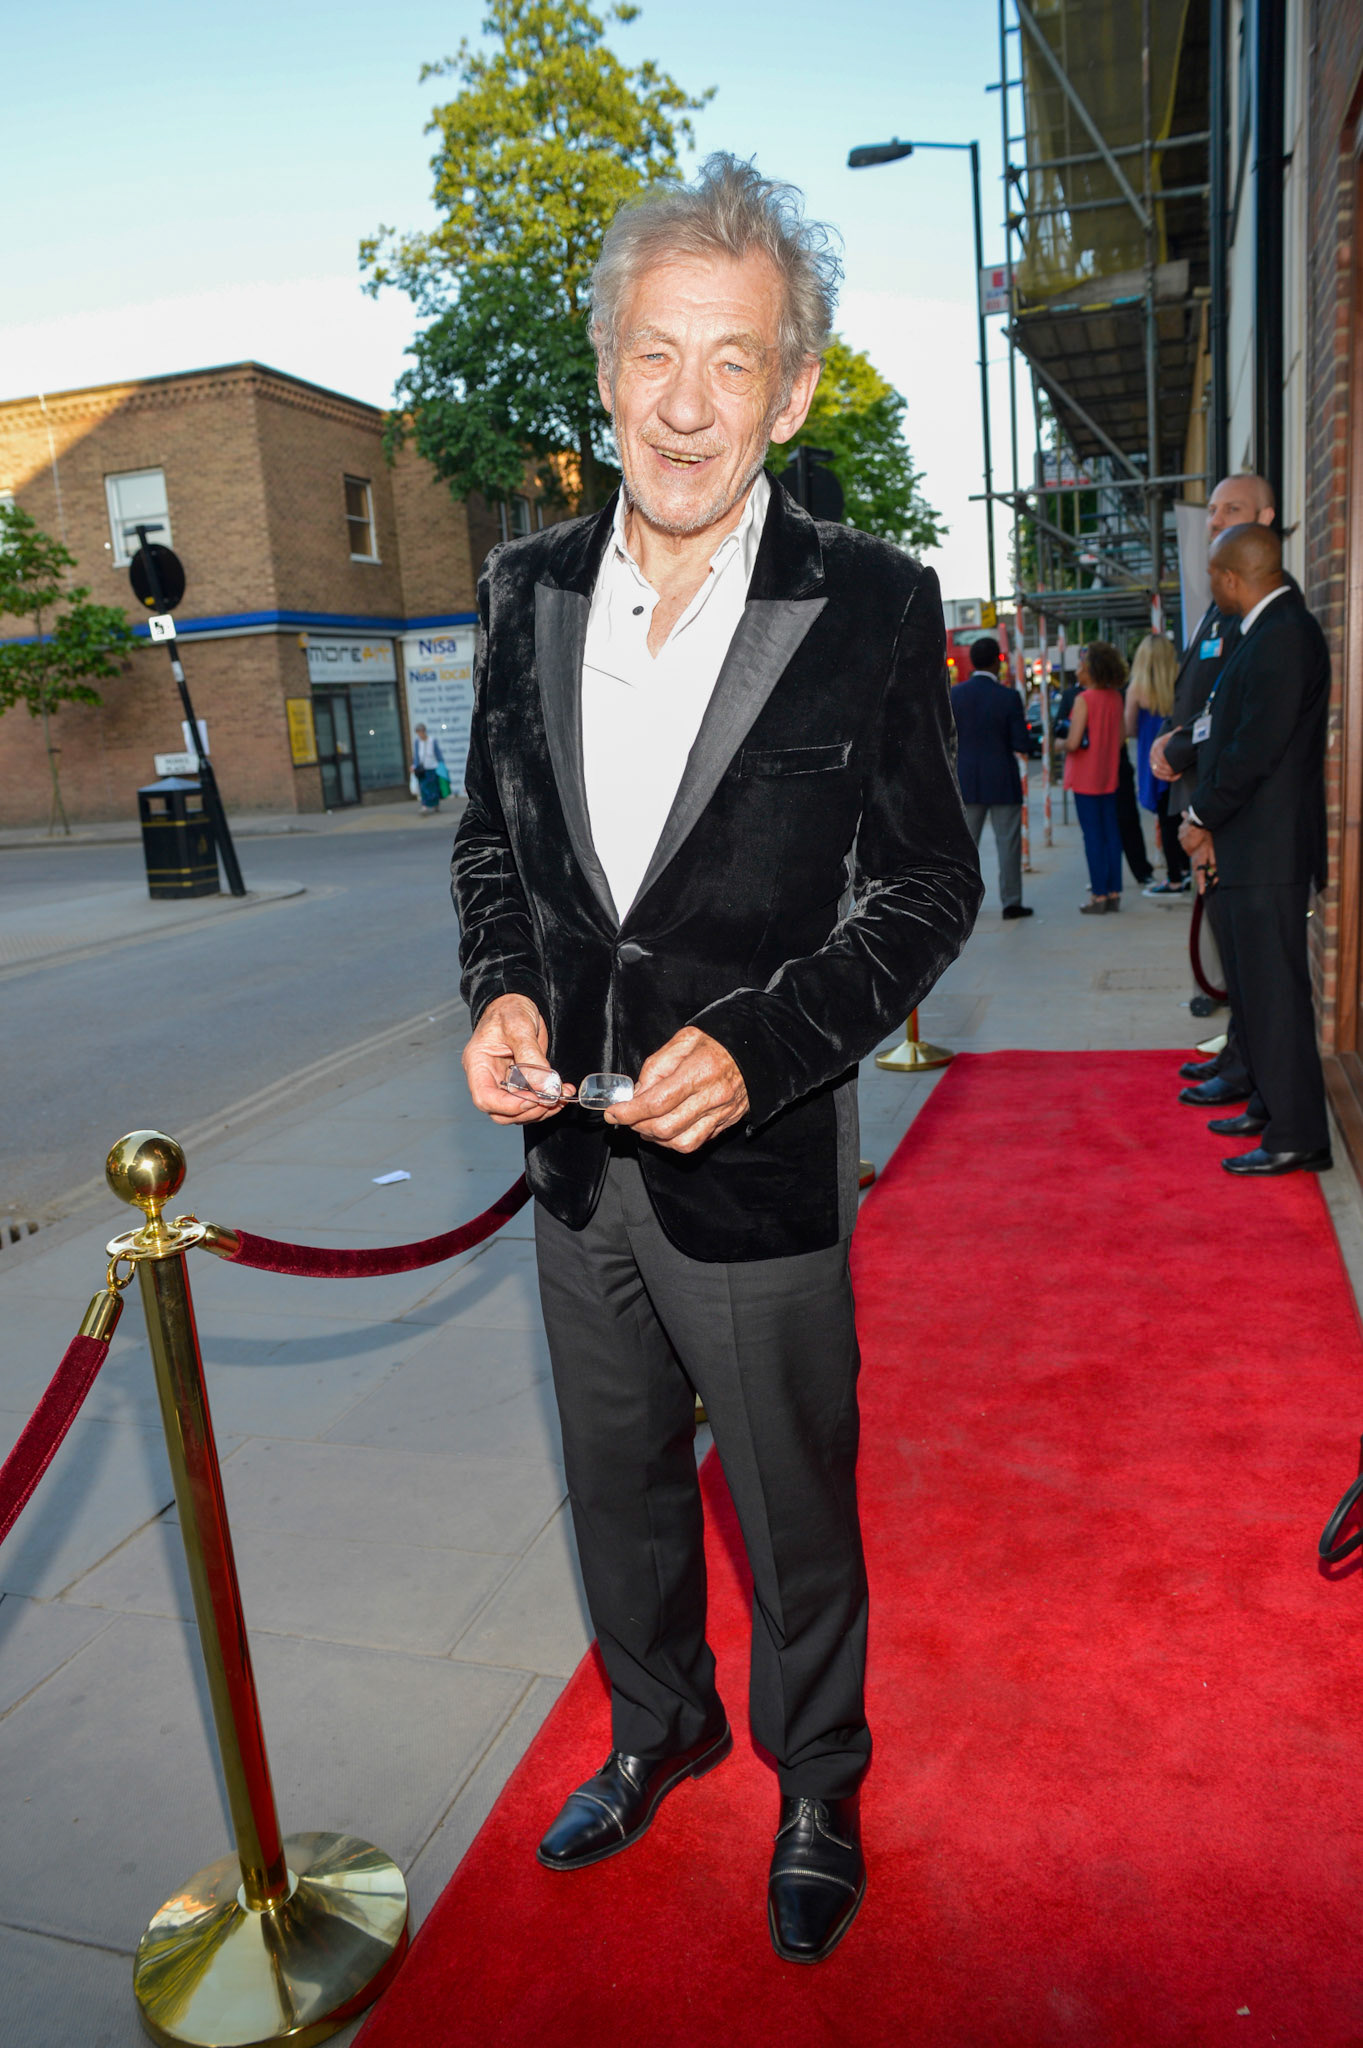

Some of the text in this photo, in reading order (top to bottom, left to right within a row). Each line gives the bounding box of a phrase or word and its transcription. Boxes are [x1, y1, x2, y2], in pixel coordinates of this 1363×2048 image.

[419, 636, 456, 655] Nisa
[409, 669, 437, 683] Nisa
[440, 666, 470, 681] local
